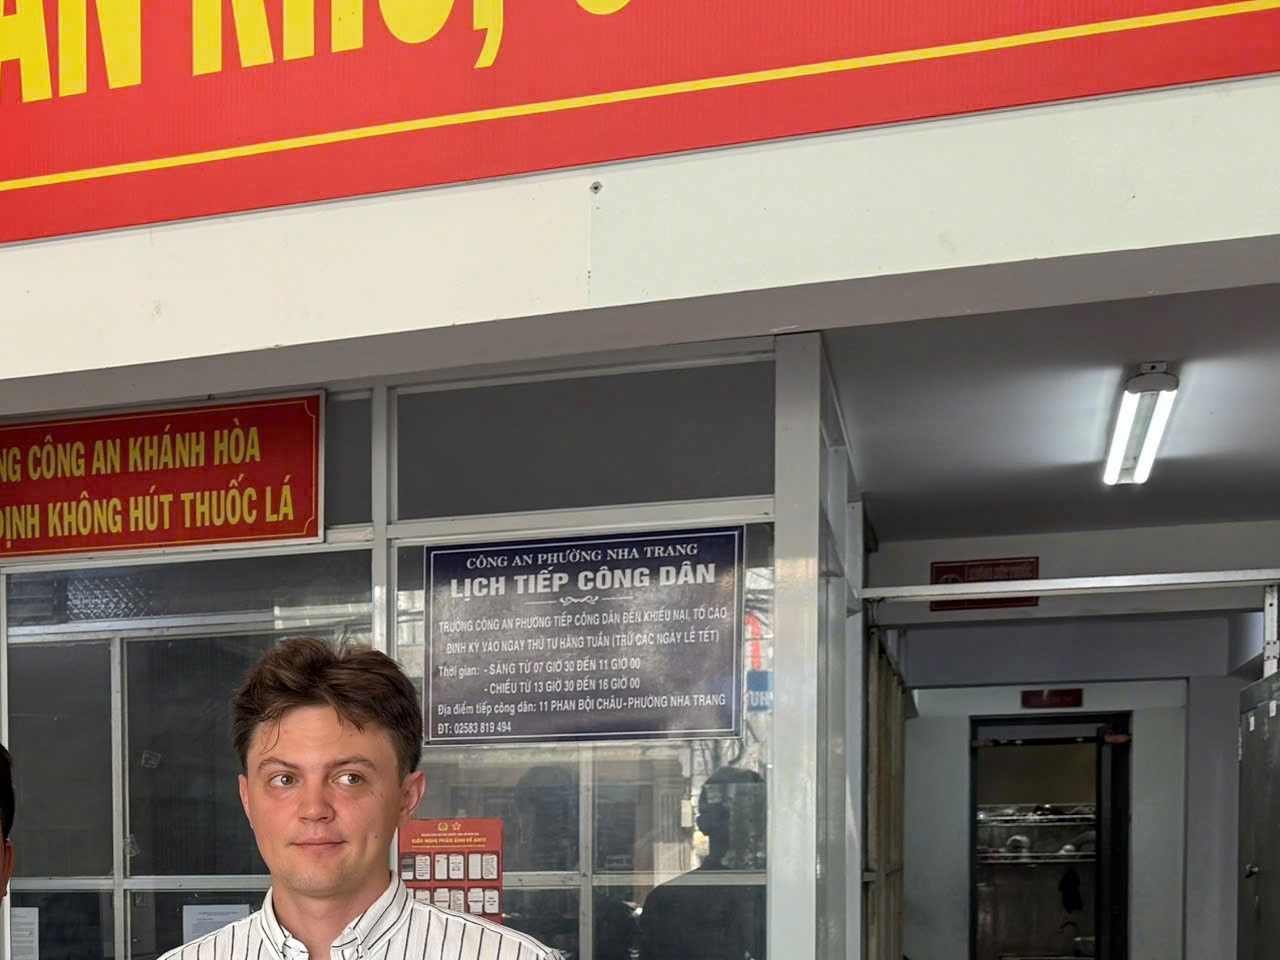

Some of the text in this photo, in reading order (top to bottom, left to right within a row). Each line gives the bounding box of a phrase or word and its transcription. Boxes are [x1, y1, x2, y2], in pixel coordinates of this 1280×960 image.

[28, 434, 86, 481] CÔNG
[92, 438, 121, 475] AN
[128, 423, 205, 473] KHÁNH
[214, 417, 261, 466] HÒA
[48, 490, 121, 538] KHÔNG
[129, 485, 173, 533] HÚT
[181, 473, 257, 528] THUỐC
[266, 475, 294, 522] LÁ
[466, 544, 698, 569] CÔNG AN PHƯỜNG NHA TRANG
[450, 560, 715, 601] LỊCH TIẾP CÔNG DÂN
[501, 617, 513, 630] AN
[554, 610, 572, 627] TIẾP
[574, 610, 600, 626] CÔNG
[602, 609, 620, 625] DÂN
[459, 666, 480, 679] gian:
[534, 661, 543, 673] 07
[564, 660, 574, 672] 30
[576, 655, 596, 672] ĐẾN
[599, 659, 608, 670] 11
[630, 657, 640, 669] 00
[534, 681, 544, 693] 13
[564, 680, 574, 692] 30
[576, 674, 596, 691] ĐẾN
[598, 678, 608, 690] 16
[611, 675, 627, 690] GIỜ
[630, 677, 640, 689] 00
[438, 704, 451, 717] Địa
[476, 700, 492, 716] tiếp
[494, 701, 516, 715] công
[517, 701, 537, 713] dân:
[539, 701, 548, 711] 11
[550, 699, 576, 712] PHAN
[578, 697, 594, 713] BỘI
[670, 695, 690, 707] NHA
[693, 694, 726, 706] TRANG
[438, 723, 452, 735] ĐT:
[480, 722, 495, 733] 819
[496, 721, 512, 733] 494
